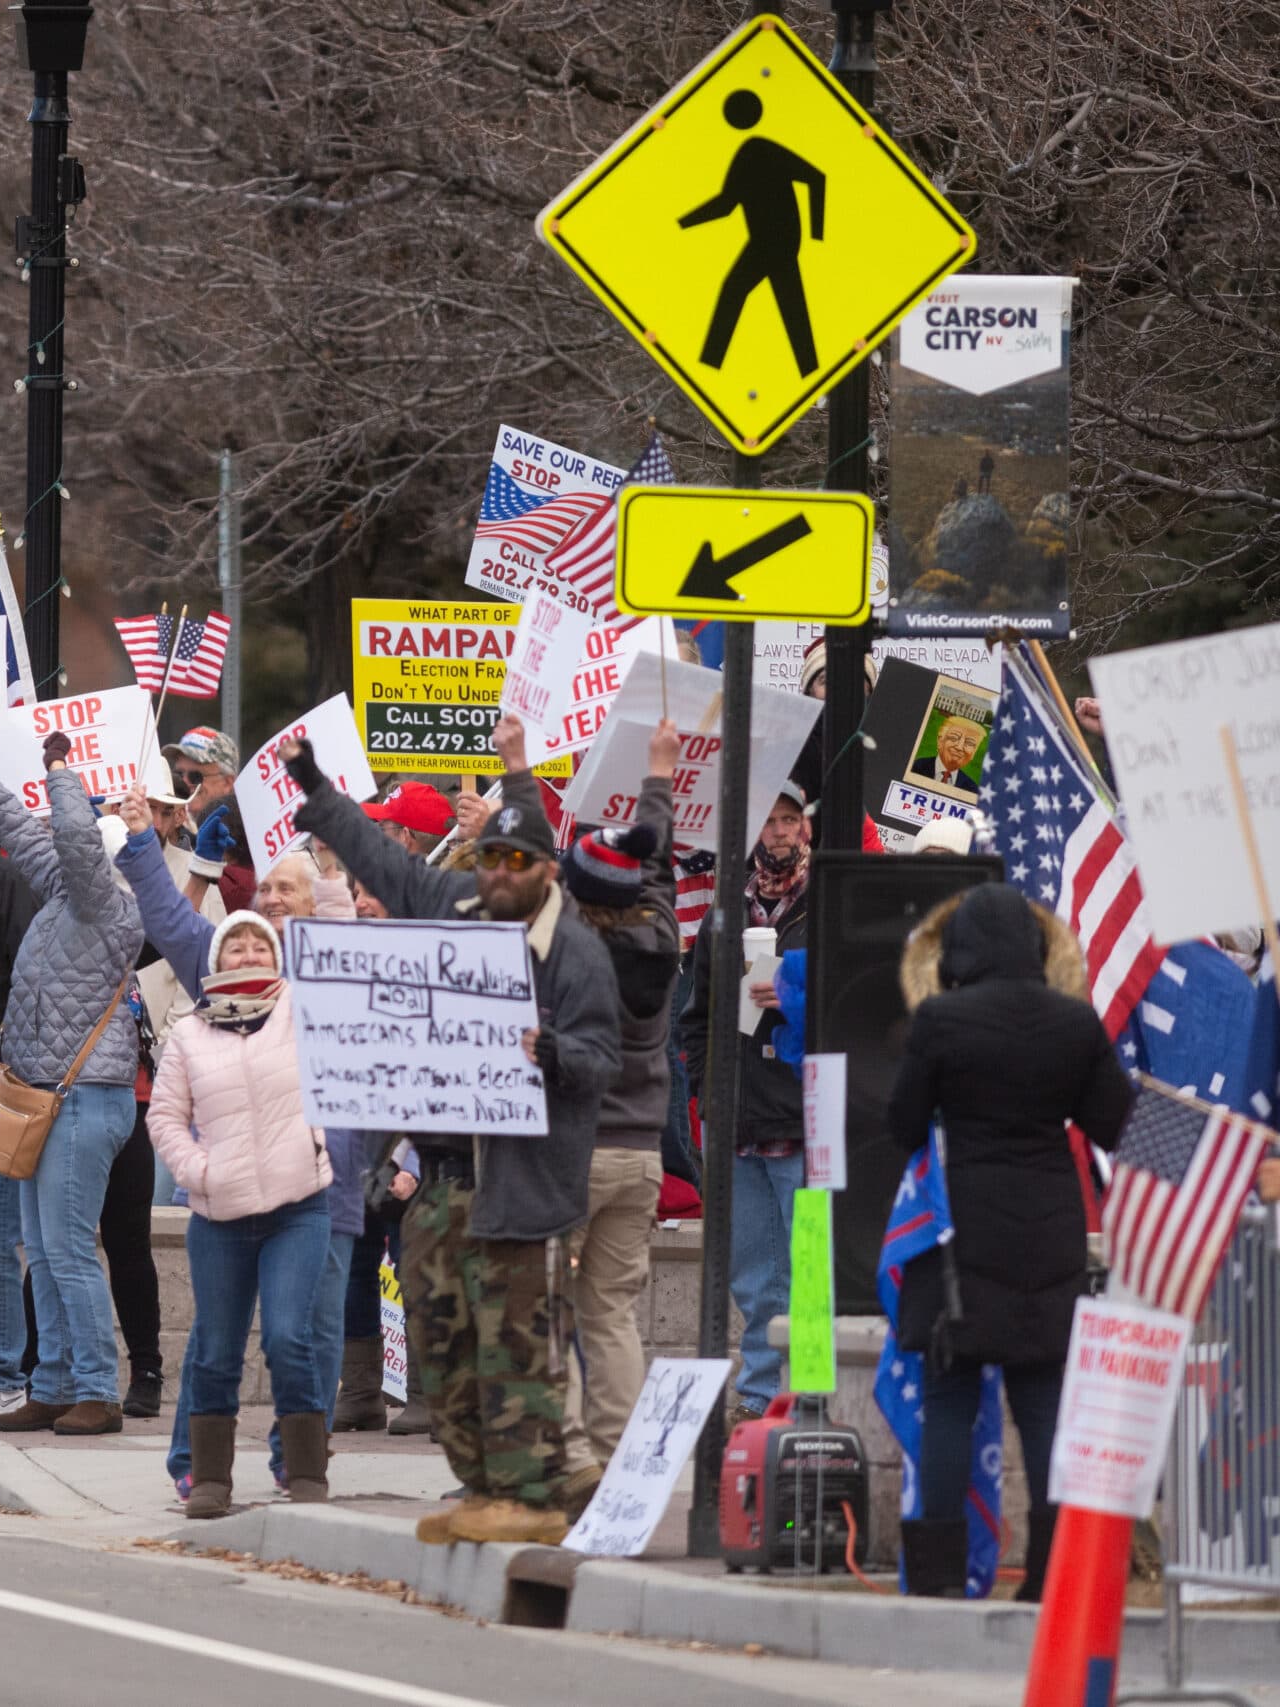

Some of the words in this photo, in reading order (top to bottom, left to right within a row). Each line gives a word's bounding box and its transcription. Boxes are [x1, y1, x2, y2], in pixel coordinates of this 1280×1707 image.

[926, 295, 960, 303] VISIT
[925, 307, 1037, 328] CARSON
[925, 330, 982, 350] CITY
[986, 336, 1003, 345] NV
[502, 431, 545, 462] SAVE
[550, 451, 586, 478] OUR
[592, 466, 624, 490] REP
[510, 459, 561, 489] STOP
[499, 542, 537, 571] CALL
[479, 578, 505, 595] DEMAND
[504, 587, 520, 600] THEY
[409, 607, 448, 620] WHAT
[454, 608, 488, 621] PART
[494, 609, 511, 621] OF
[531, 598, 562, 635] STOP
[905, 614, 1053, 630] VisitCarsonCity.com
[522, 637, 547, 673] THE
[584, 627, 621, 659] OP
[753, 643, 808, 658] LAWYE
[872, 646, 928, 661] OUNDER
[934, 648, 990, 662] NEVADA
[475, 662, 507, 679] FRA
[770, 663, 802, 679] EQU
[33, 697, 102, 734] STOP
[439, 708, 499, 727] SCOT
[66, 733, 102, 764] HE
[370, 732, 497, 752] 202.479.30
[368, 757, 394, 768] EMAND
[396, 758, 416, 768] THEY
[417, 759, 438, 768] HEAR
[439, 759, 470, 769] POWELL
[472, 760, 491, 769] CASE
[272, 774, 304, 806] TH
[672, 768, 700, 794] HE
[899, 788, 967, 820] TRUM
[902, 802, 942, 821] PEN
[1080, 1312, 1183, 1354] TEMPORARY
[1099, 1348, 1173, 1388] PARKING
